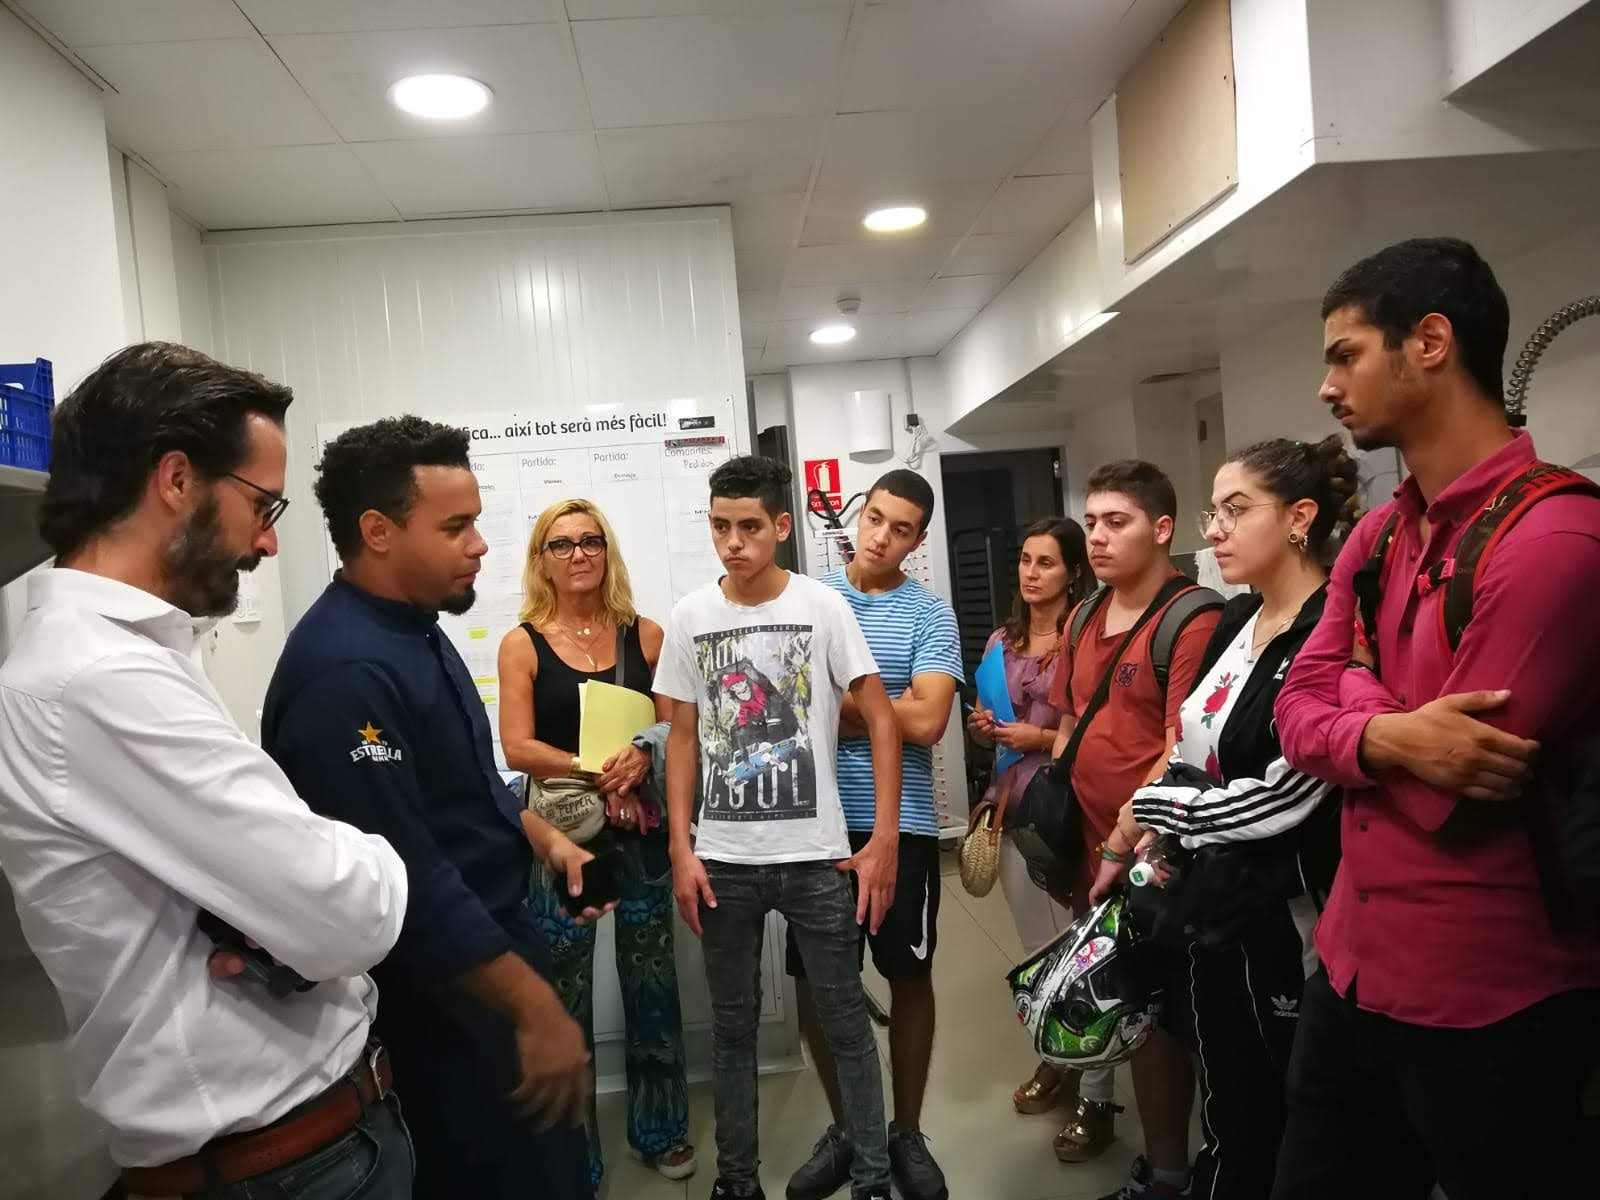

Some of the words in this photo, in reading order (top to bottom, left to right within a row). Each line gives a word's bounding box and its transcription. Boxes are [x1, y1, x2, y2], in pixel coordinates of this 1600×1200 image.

[505, 420, 532, 438] així
[536, 421, 557, 436] tot
[561, 416, 592, 434] serà
[596, 415, 626, 431] més
[629, 412, 667, 433] fàcil!
[521, 457, 557, 469] Partida:
[593, 451, 629, 463] Partida:
[349, 744, 402, 763] ESTRELLA
[558, 795, 596, 816] PEPPER
